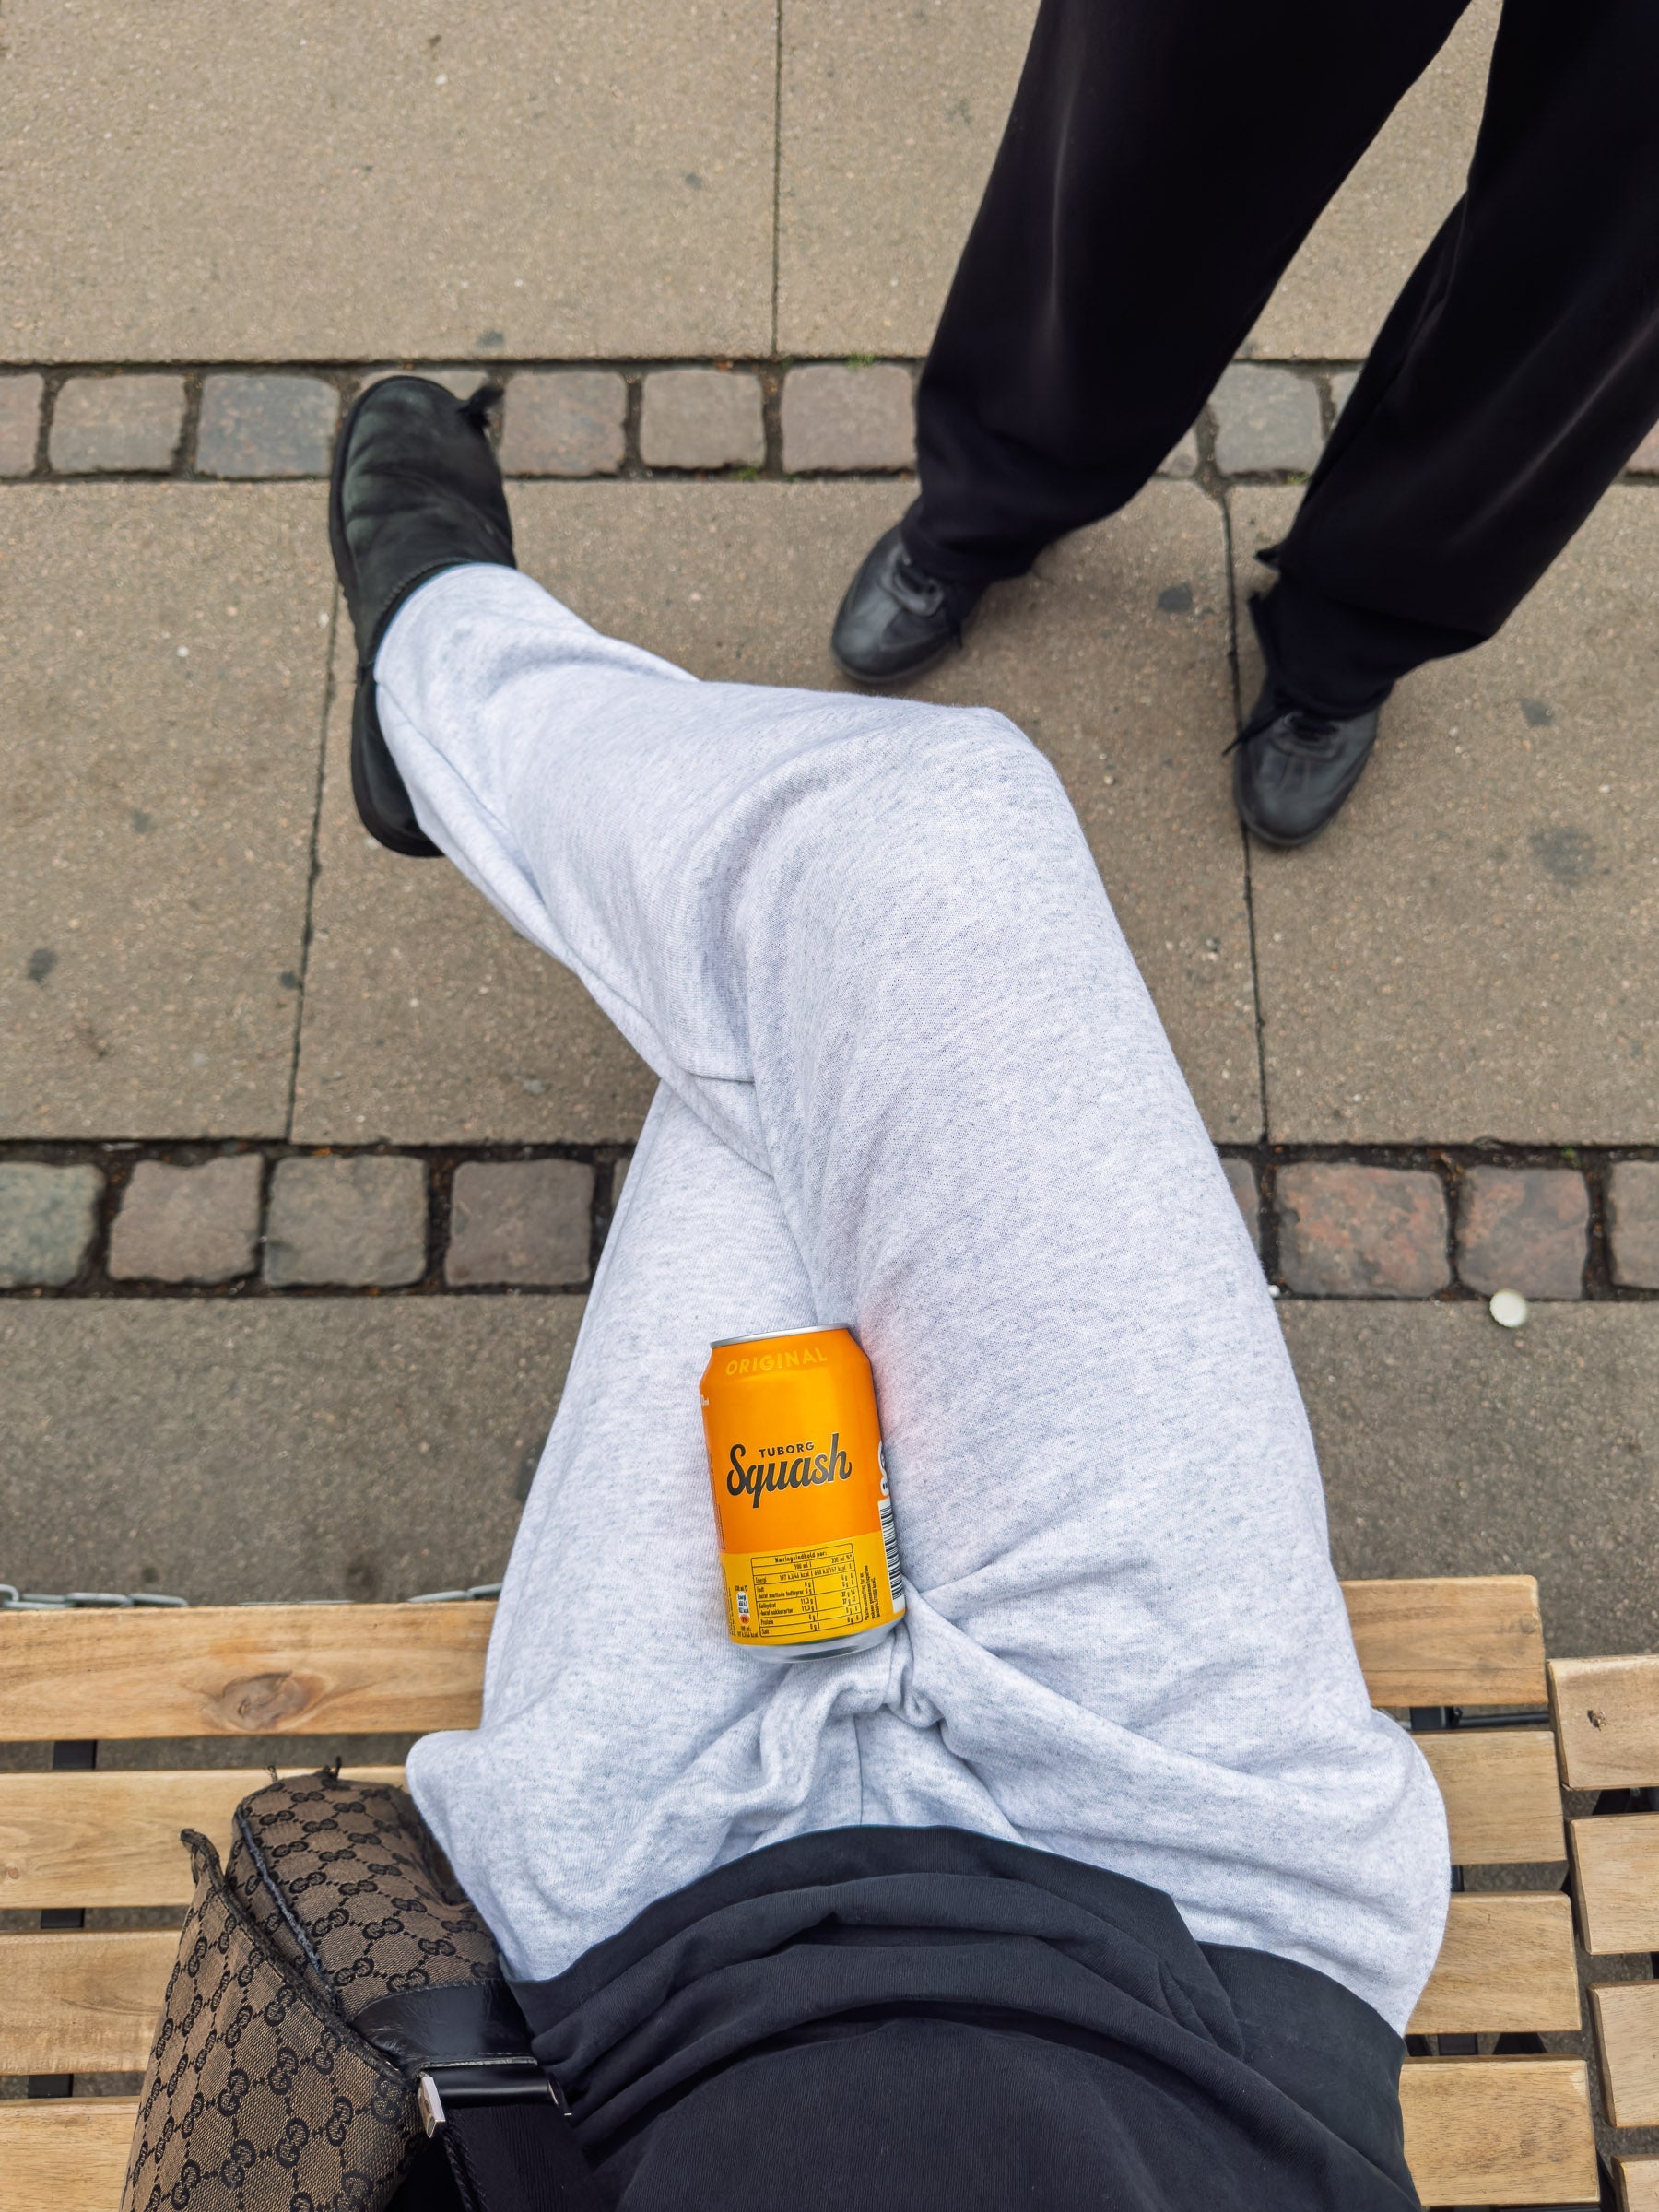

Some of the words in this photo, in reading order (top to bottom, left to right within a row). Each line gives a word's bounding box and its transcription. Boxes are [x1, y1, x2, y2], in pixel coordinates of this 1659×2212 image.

[725, 1347, 828, 1376] ORIGINAL
[759, 1441, 815, 1458] TUBORG
[726, 1432, 853, 1509] Squash
